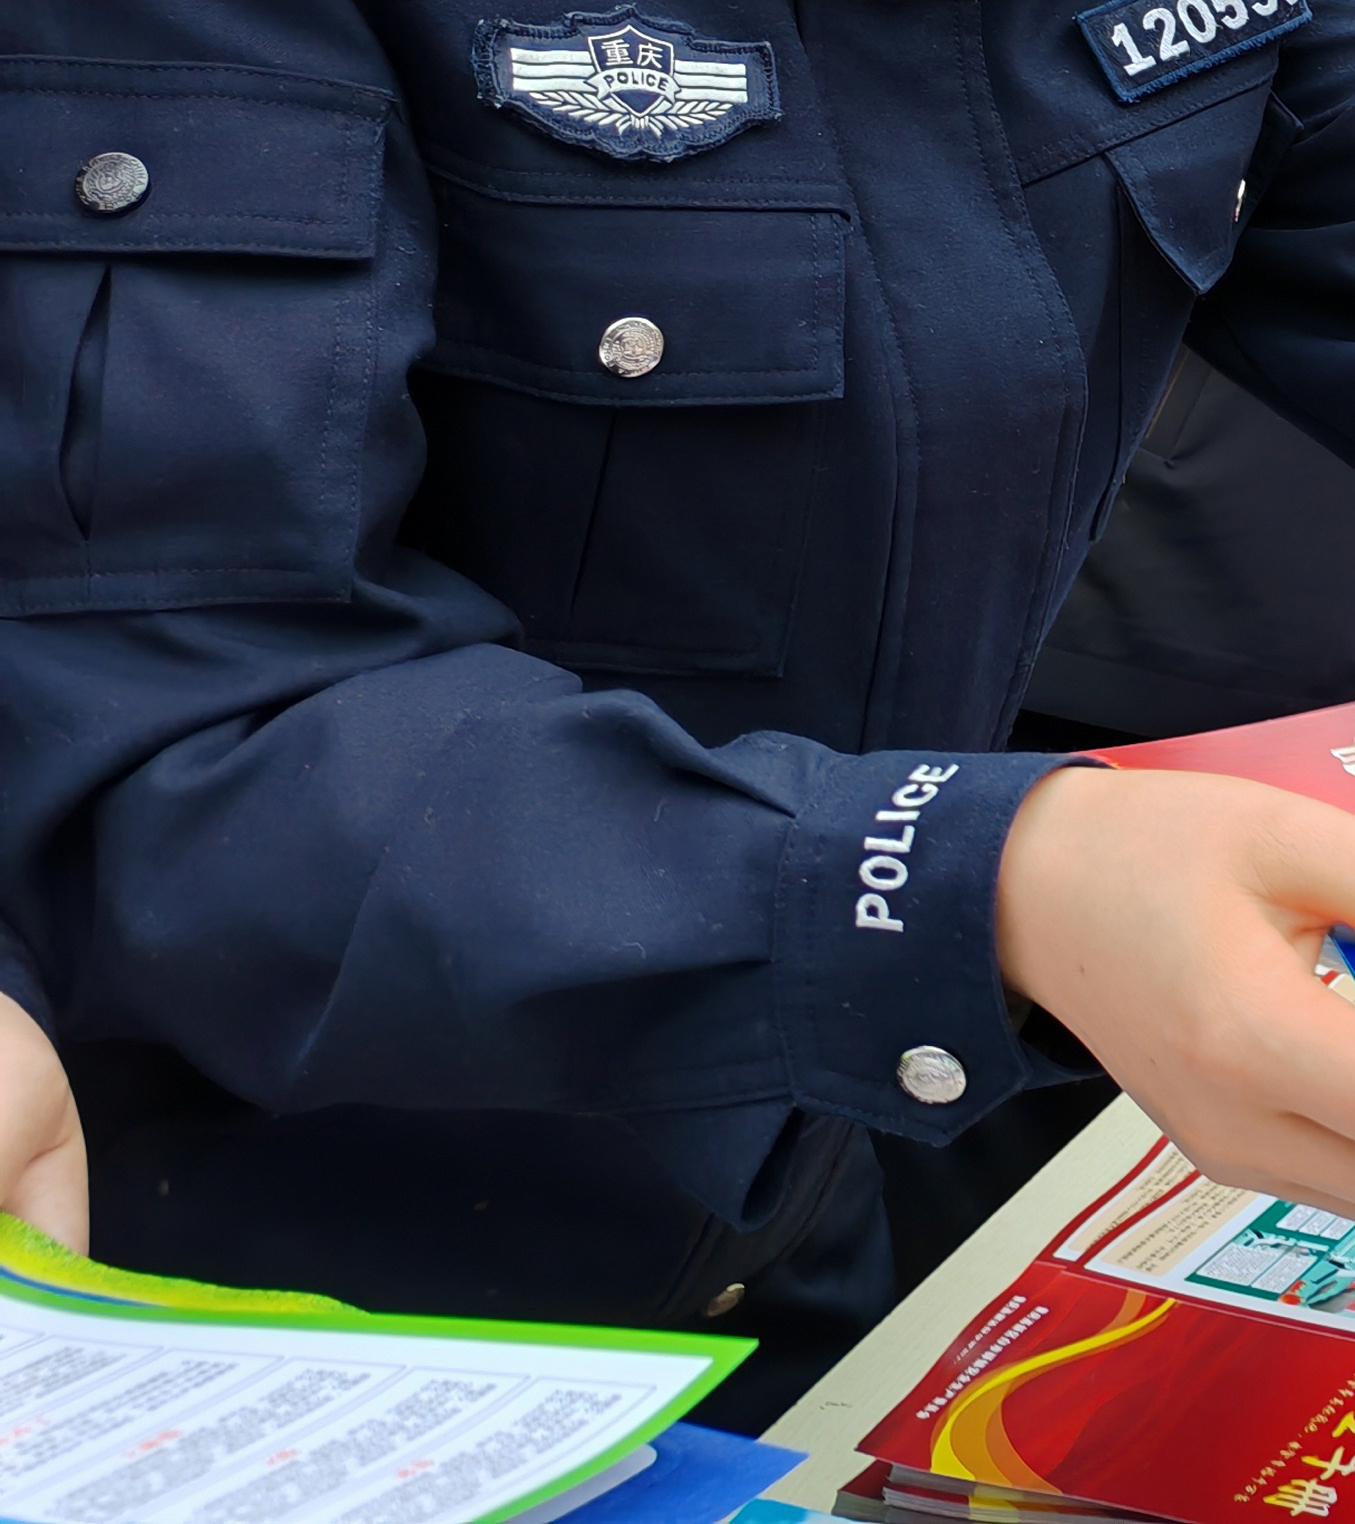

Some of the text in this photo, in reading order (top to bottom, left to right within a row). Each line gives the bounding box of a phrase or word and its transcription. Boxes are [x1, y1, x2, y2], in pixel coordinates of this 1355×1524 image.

[601, 38, 664, 69] 重庆
[603, 71, 669, 92] POLICE
[856, 763, 960, 932] POLICE
